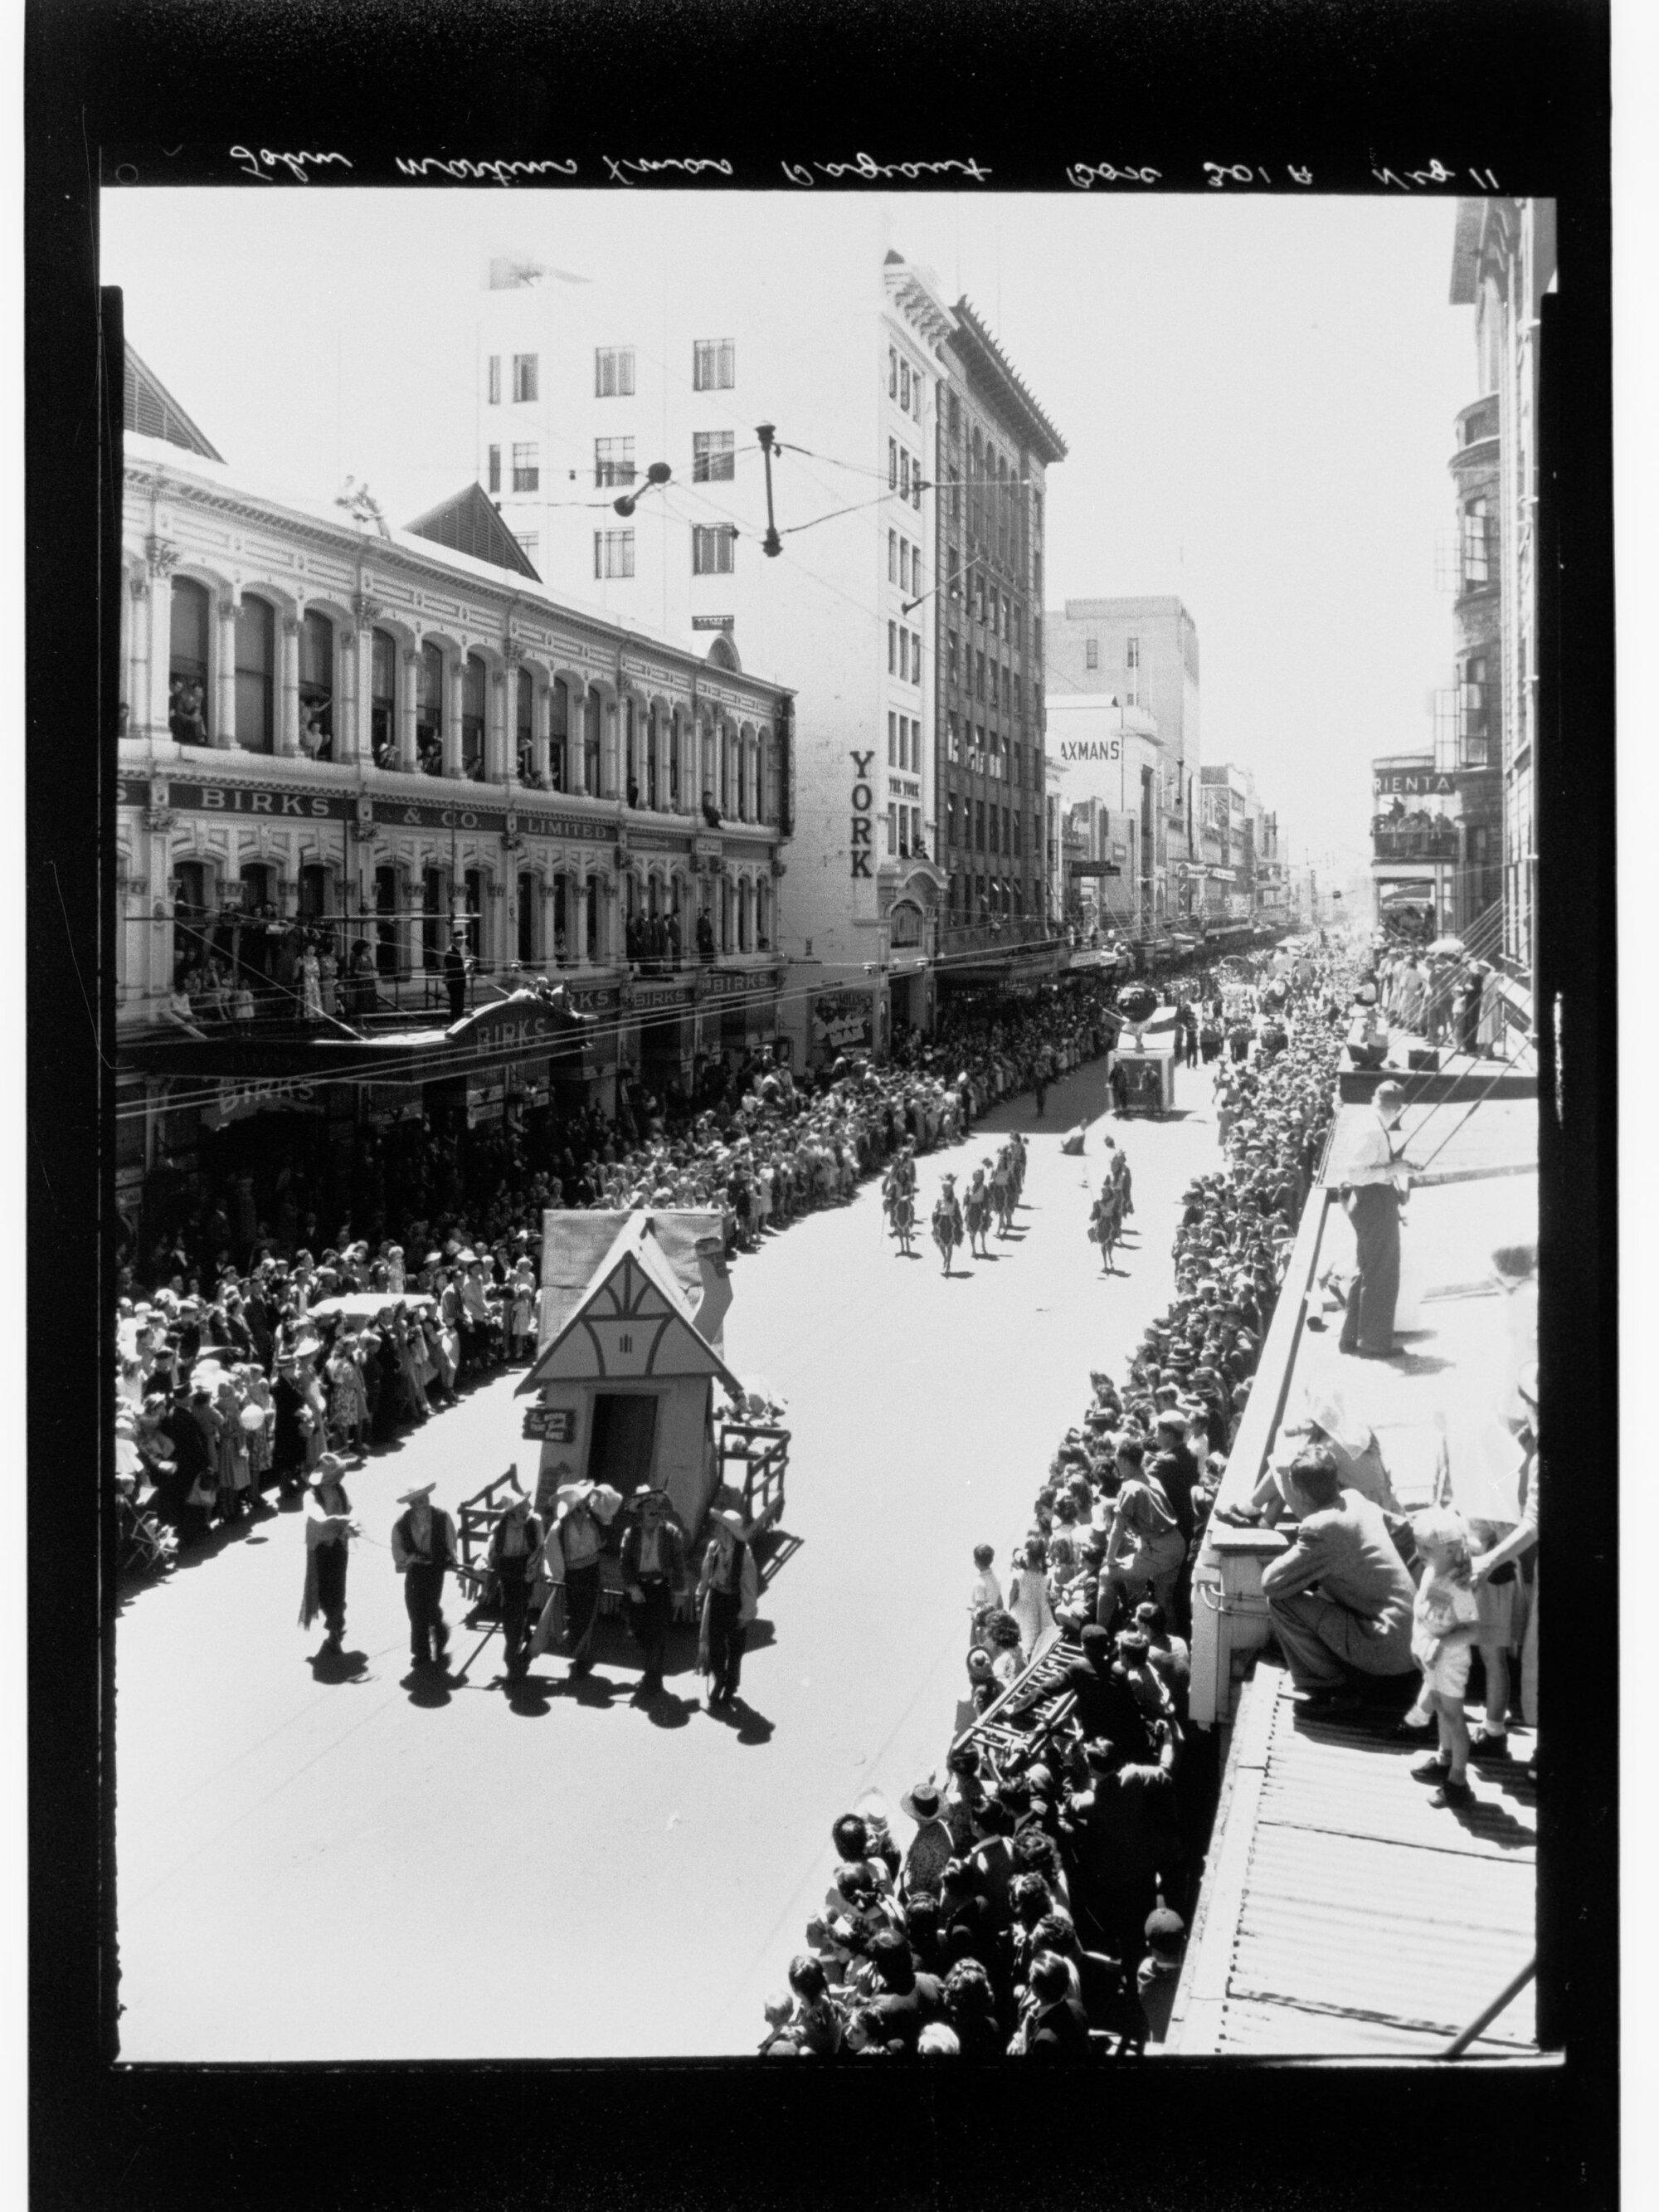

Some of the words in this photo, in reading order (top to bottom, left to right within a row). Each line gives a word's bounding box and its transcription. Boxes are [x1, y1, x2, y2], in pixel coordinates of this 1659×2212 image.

[201, 787, 330, 817] BIRKS
[404, 806, 423, 825] &
[527, 817, 607, 840] LIMITED
[850, 750, 873, 878] YORK
[567, 989, 610, 1009] RKS
[633, 987, 687, 1009] BIRKS
[711, 972, 768, 994] BIRKS
[477, 1017, 547, 1055] BIRKS
[218, 1075, 315, 1116] BIRKS
